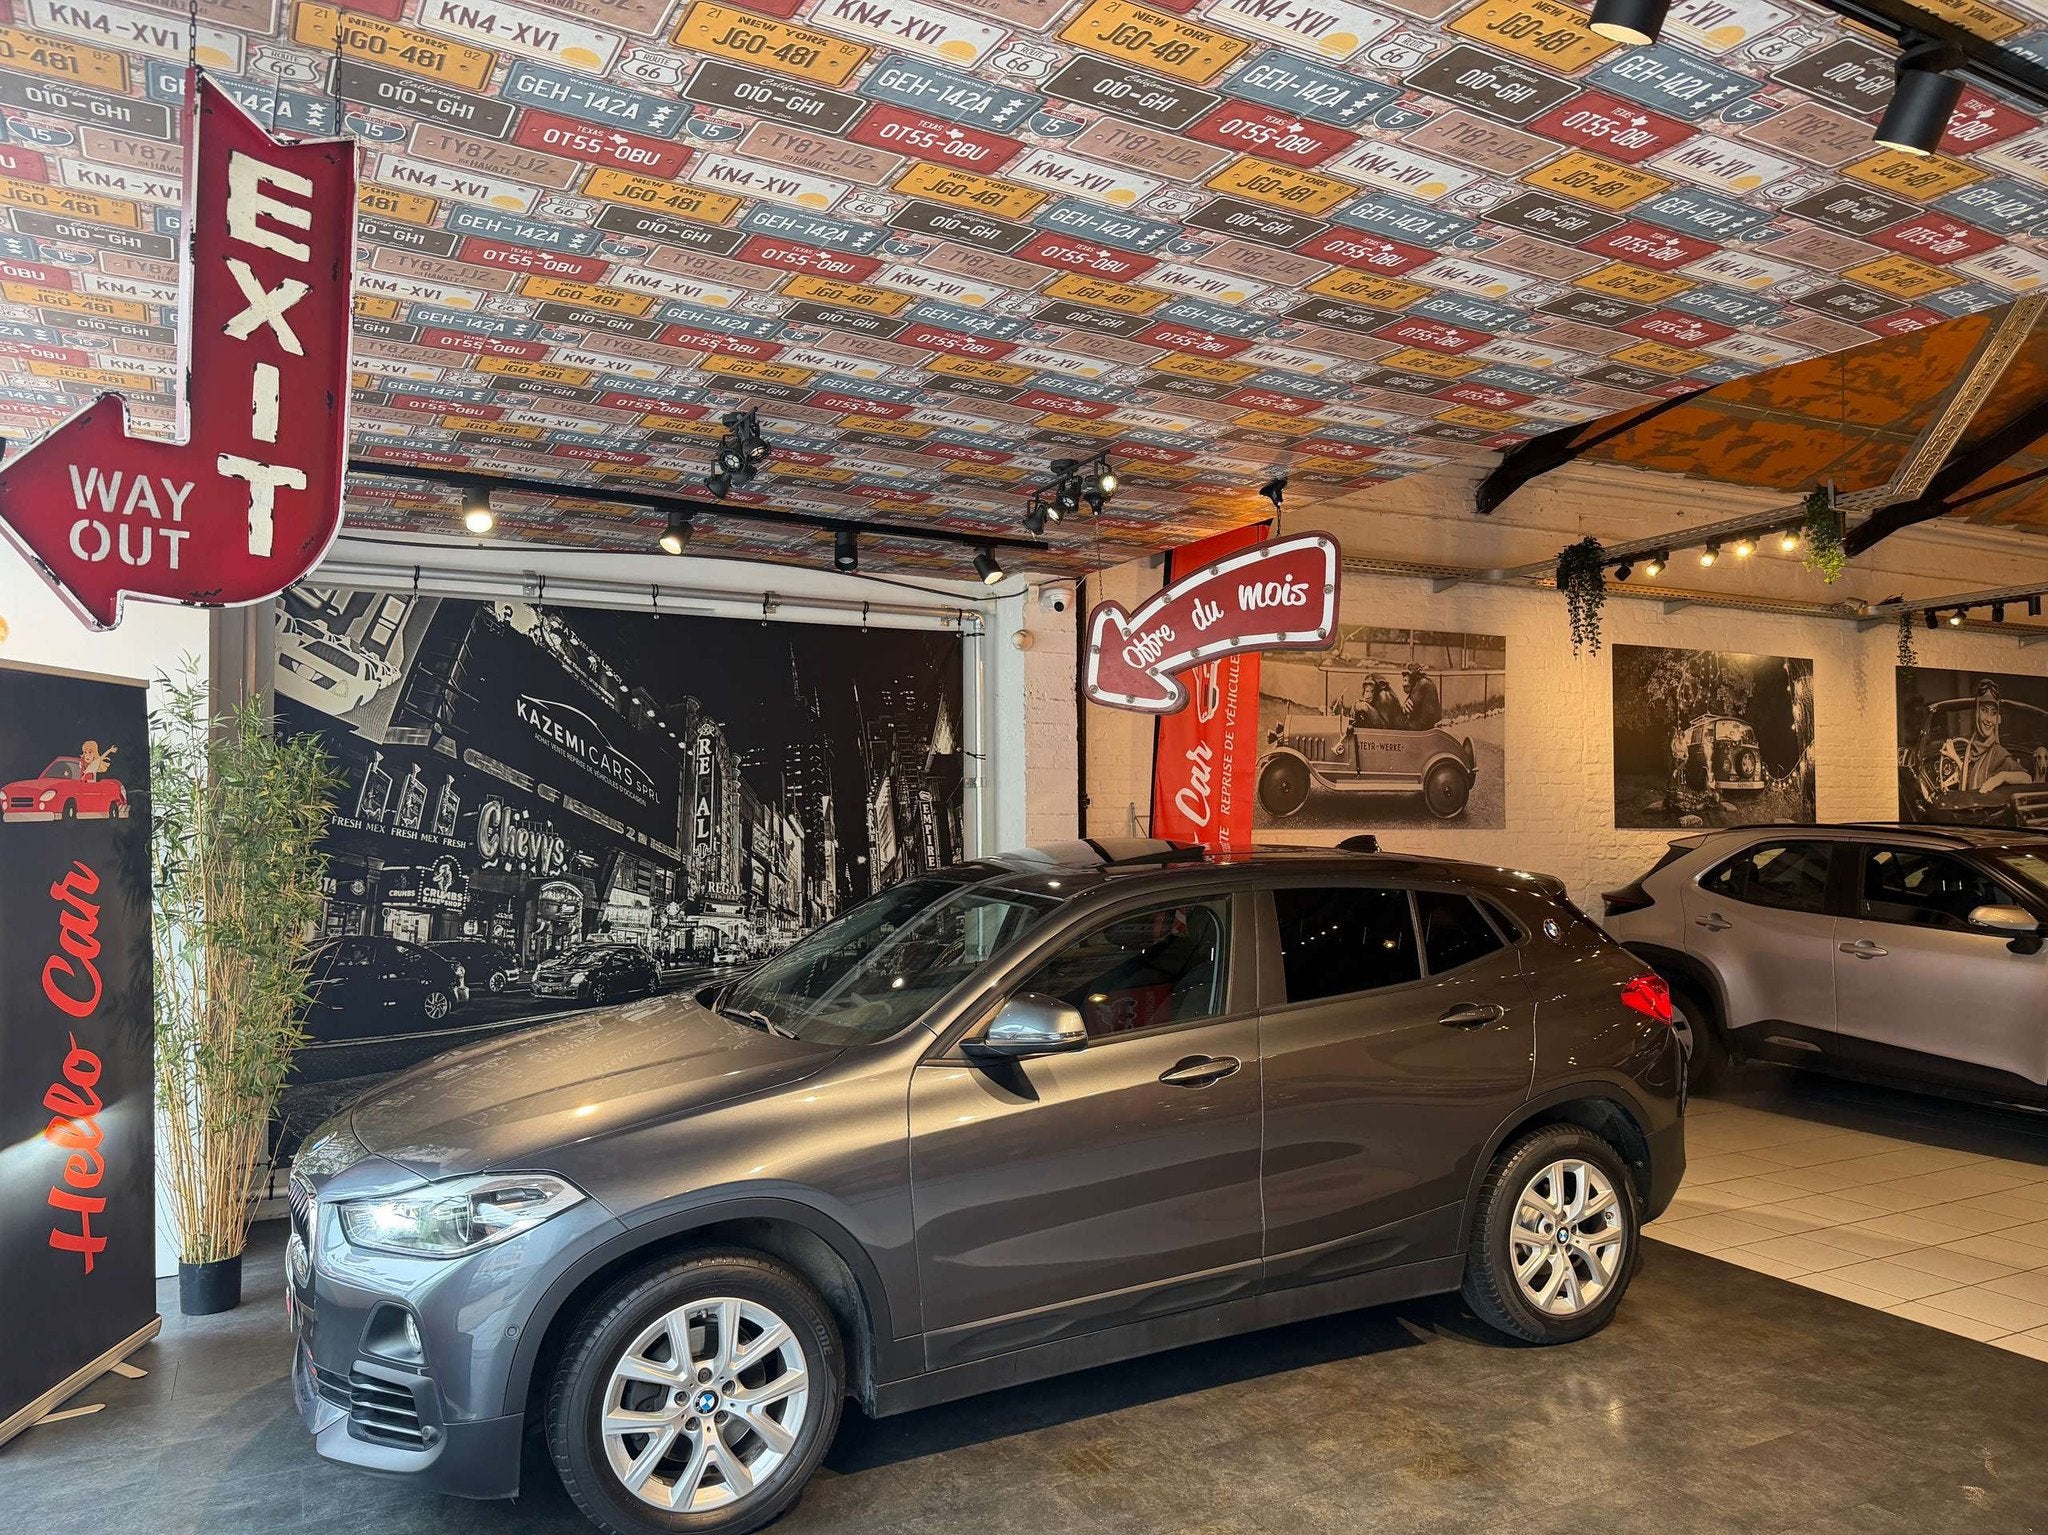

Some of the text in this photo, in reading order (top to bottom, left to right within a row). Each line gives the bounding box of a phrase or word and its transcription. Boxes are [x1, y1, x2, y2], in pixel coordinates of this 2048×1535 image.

[347, 16, 451, 48] NEW YORK
[737, 15, 830, 47] NEW YORK
[1133, 9, 1213, 45] NEW YORK
[1401, 37, 1424, 50] ROUTE
[271, 51, 298, 62] ROUTE
[643, 54, 669, 66] ROUTE
[1006, 58, 1031, 73] 66
[1379, 49, 1407, 65] 66
[270, 61, 296, 76] 66
[638, 65, 660, 80] 66
[1612, 54, 1712, 101] GEH-142A
[44, 83, 114, 103] California
[400, 79, 463, 99] California
[760, 77, 817, 97] California
[879, 68, 994, 114] GEH-142A
[1124, 73, 1176, 93] California
[1242, 64, 1351, 108] GEH-142A
[516, 74, 640, 120] GEH-142A
[1261, 114, 1288, 127] TEXAS
[1385, 111, 1411, 125] 15
[1609, 107, 1635, 120] TEXAS
[1733, 104, 1761, 118] 15
[28, 128, 55, 142] 15
[364, 123, 386, 137] 15
[576, 125, 605, 137] TEXAS
[701, 123, 724, 137] 15
[917, 119, 944, 132] TEXAS
[1040, 118, 1065, 132] 15
[855, 203, 875, 214] 66
[1157, 200, 1178, 211] 66
[1652, 196, 1734, 228] GEH-142A
[457, 213, 560, 244] GEH-142A
[752, 211, 850, 242] GEH-142A
[1050, 208, 1141, 239] GEH-142A
[1349, 203, 1435, 234] GEH-142A
[217, 150, 314, 558] EXIT
[68, 464, 196, 522] WAY
[69, 518, 192, 570] OUT
[1191, 597, 1224, 631] du
[1238, 573, 1309, 611] mois
[1225, 652, 1240, 726] VÉHICULE
[1224, 728, 1234, 751] DE
[1360, 741, 1402, 751] TEYR-WERKE
[636, 781, 661, 804] SPRL
[1175, 740, 1213, 827] Car
[1221, 754, 1233, 815] REPRISE
[332, 815, 467, 849] FRESH MEX FRESH MEX FRESH
[477, 800, 565, 876] Chevys
[922, 804, 936, 867] EMPIRE
[388, 889, 416, 897] CRUMBS
[422, 887, 464, 902] CRUMBS
[42, 859, 107, 1274] Hello Car
